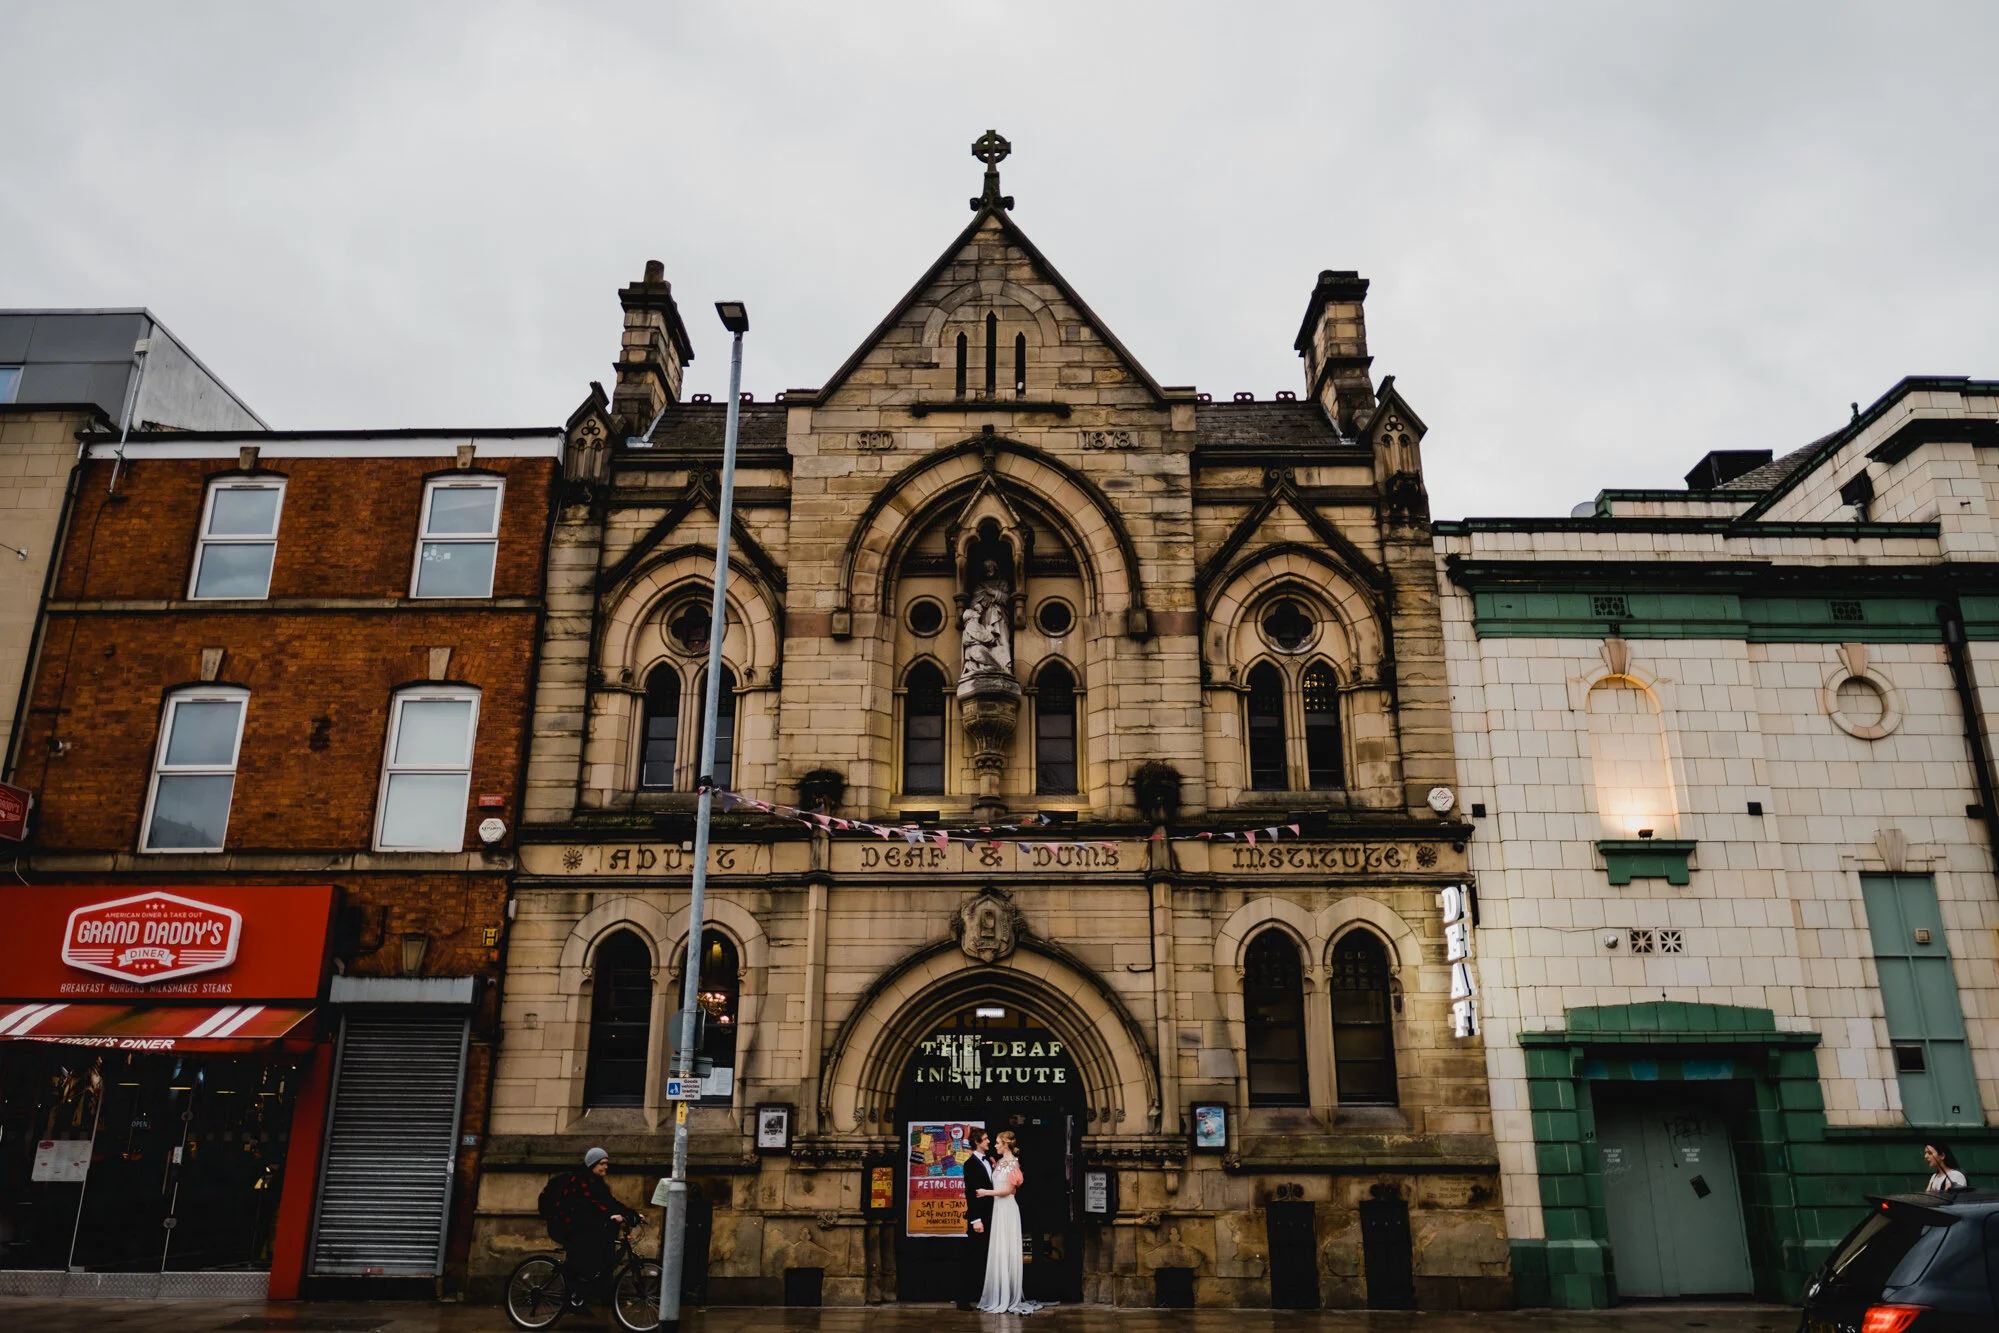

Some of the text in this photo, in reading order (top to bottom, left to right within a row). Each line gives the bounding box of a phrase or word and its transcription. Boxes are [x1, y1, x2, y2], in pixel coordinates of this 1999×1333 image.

[609, 848, 736, 870] ADUT
[861, 846, 947, 868] DEAF
[979, 846, 1003, 867] &
[1032, 846, 1120, 868] DUMB
[77, 919, 224, 945] GRAND DADDY'S
[130, 949, 166, 959] DINER
[1441, 885, 1480, 1038] DEAF
[60, 983, 233, 993] BREAKFAST BURGERS MILKSHAKES STEAKS
[119, 1039, 176, 1049] DINER
[920, 1041, 1064, 1057] THE DEAF
[131, 1120, 148, 1128] OPEN
[917, 1180, 966, 1189] PETROL GIRL
[921, 1201, 935, 1209] SAT
[915, 1209, 967, 1218] DEAF INSTITUT
